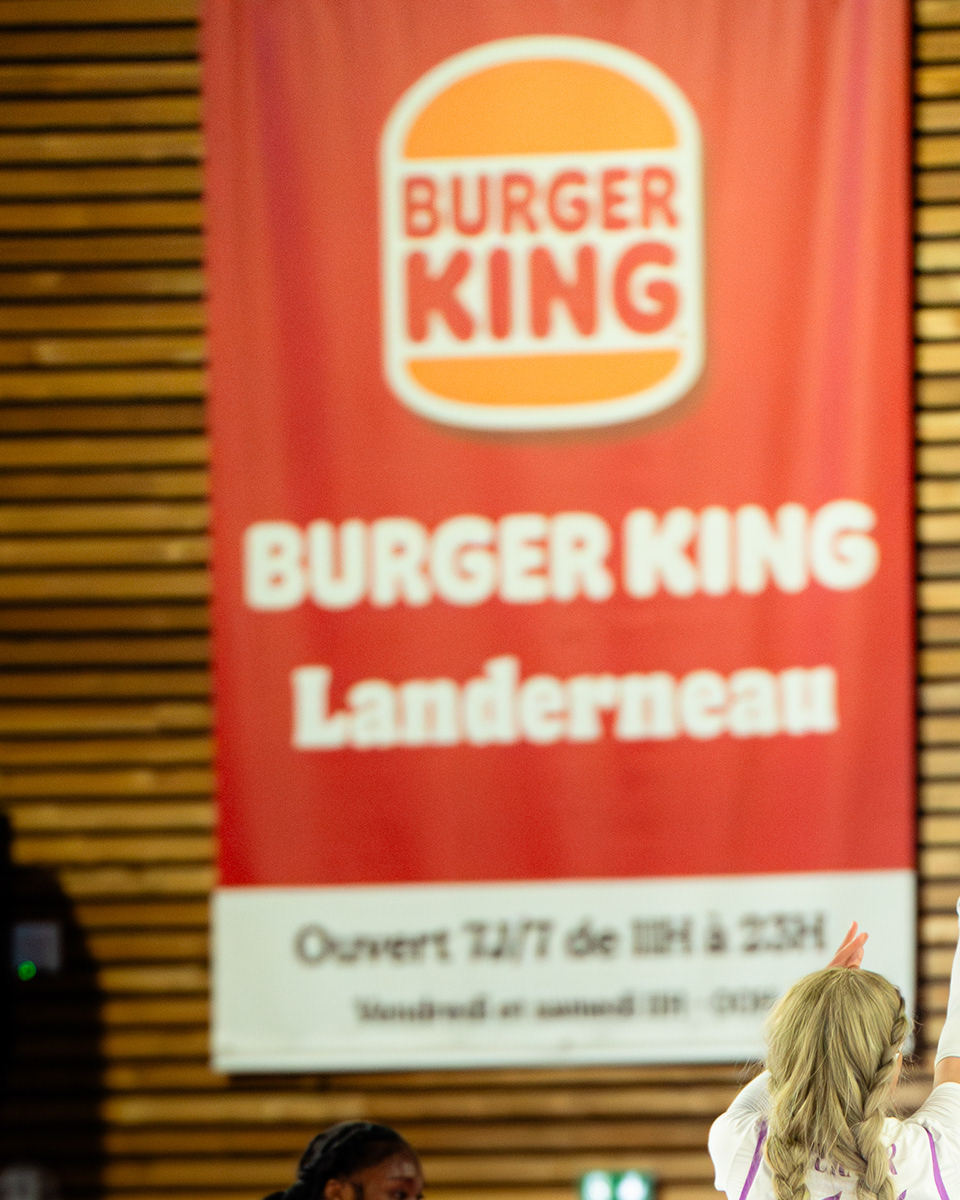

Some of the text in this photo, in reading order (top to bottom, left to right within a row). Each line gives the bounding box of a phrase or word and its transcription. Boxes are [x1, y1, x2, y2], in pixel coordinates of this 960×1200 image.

[403, 166, 679, 238] BURGER
[405, 240, 681, 343] KING
[244, 500, 879, 611] BURGER KING
[292, 655, 839, 751] Landerneau
[295, 923, 450, 967] Ouvert
[566, 918, 619, 959] de
